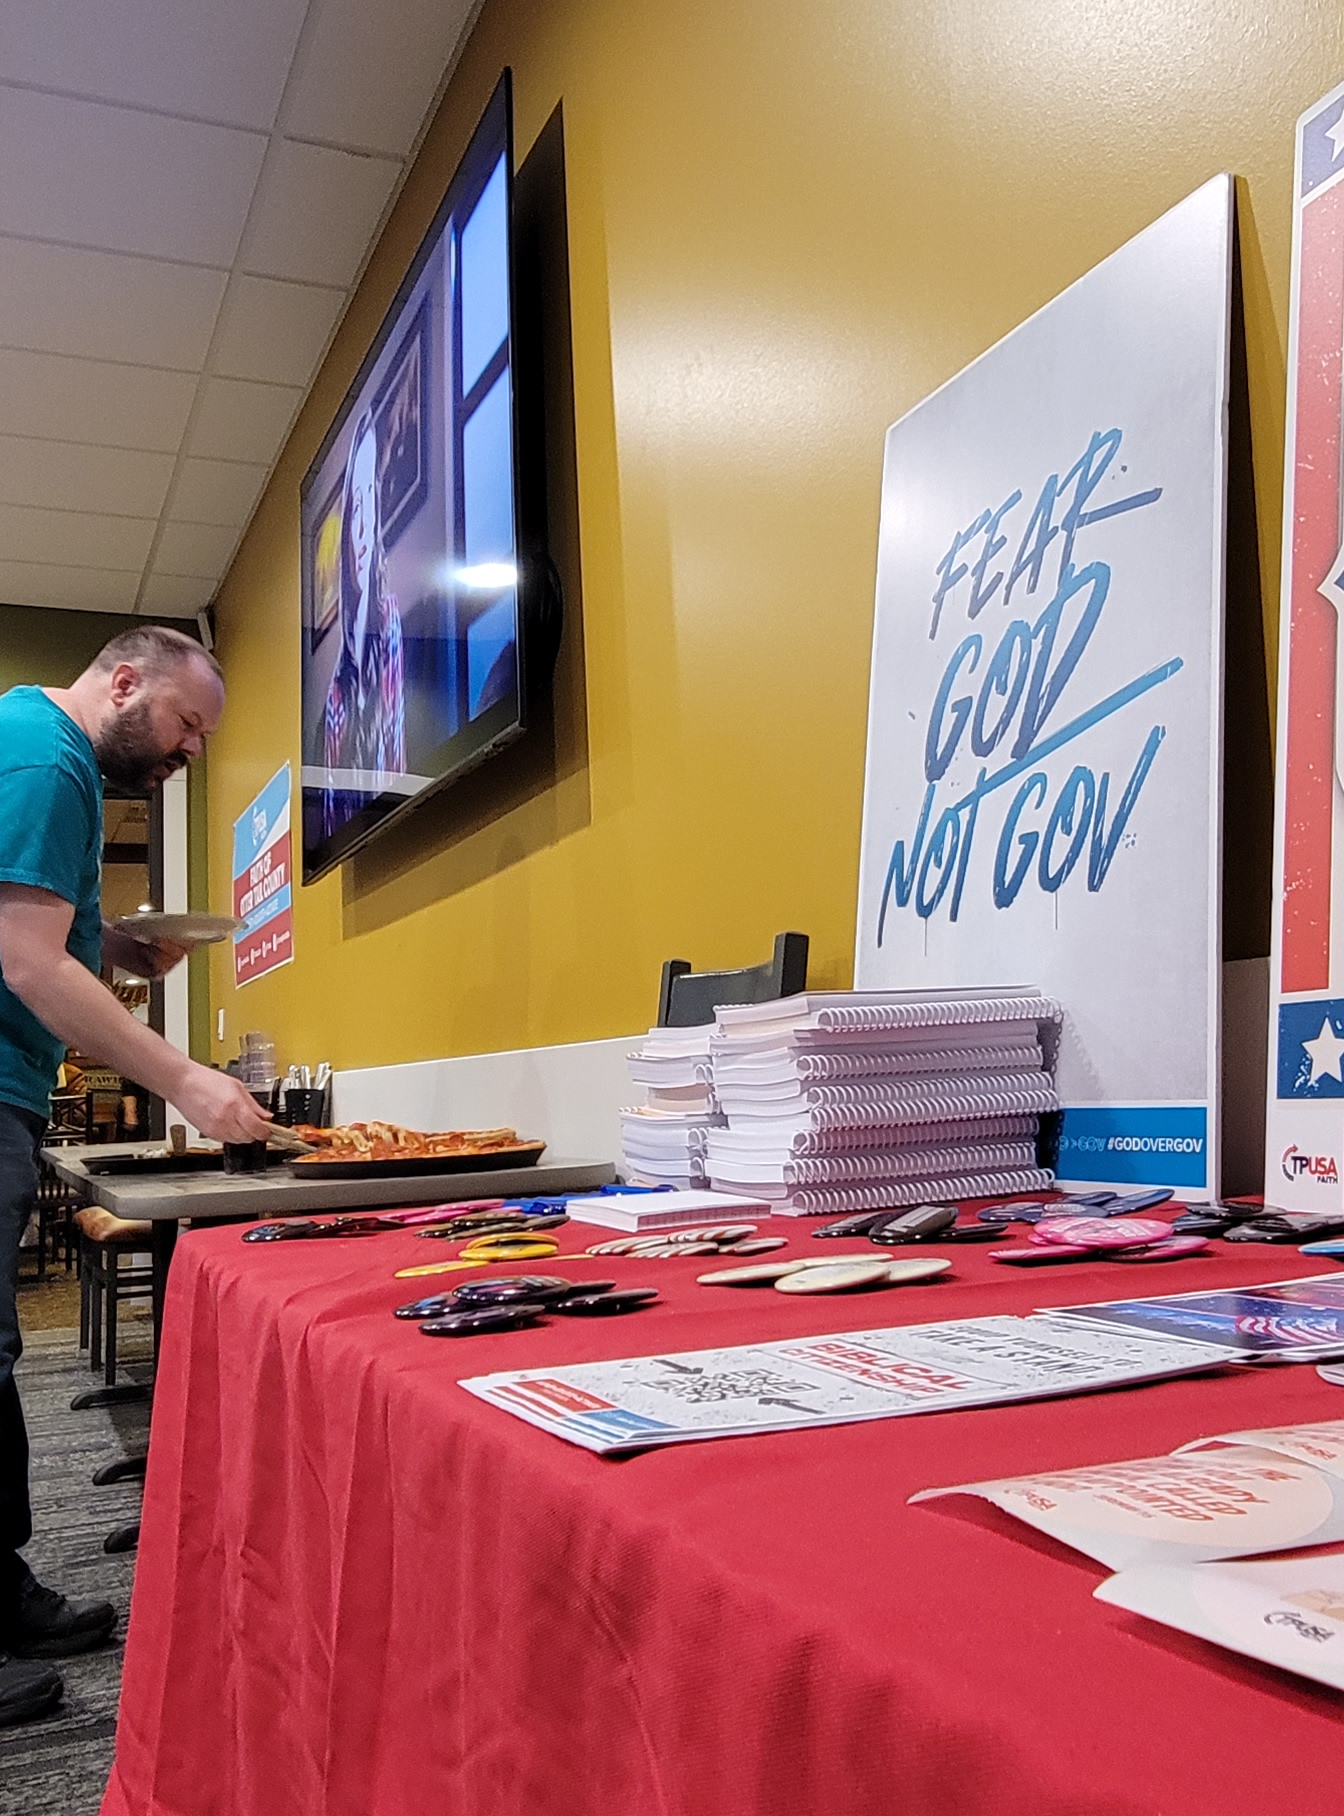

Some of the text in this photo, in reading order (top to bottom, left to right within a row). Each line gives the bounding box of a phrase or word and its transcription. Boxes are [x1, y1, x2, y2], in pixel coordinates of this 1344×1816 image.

[929, 428, 1163, 640] FEAR
[925, 561, 1112, 783] GOD
[993, 725, 1166, 909] GOV
[1107, 1136, 1203, 1152] #GODOVERGOV
[1290, 1155, 1339, 1177] TPUSA
[1316, 1175, 1339, 1185] FAITH
[778, 1347, 946, 1394] CITIZENSHIP
[809, 1342, 976, 1390] BIBLICAL
